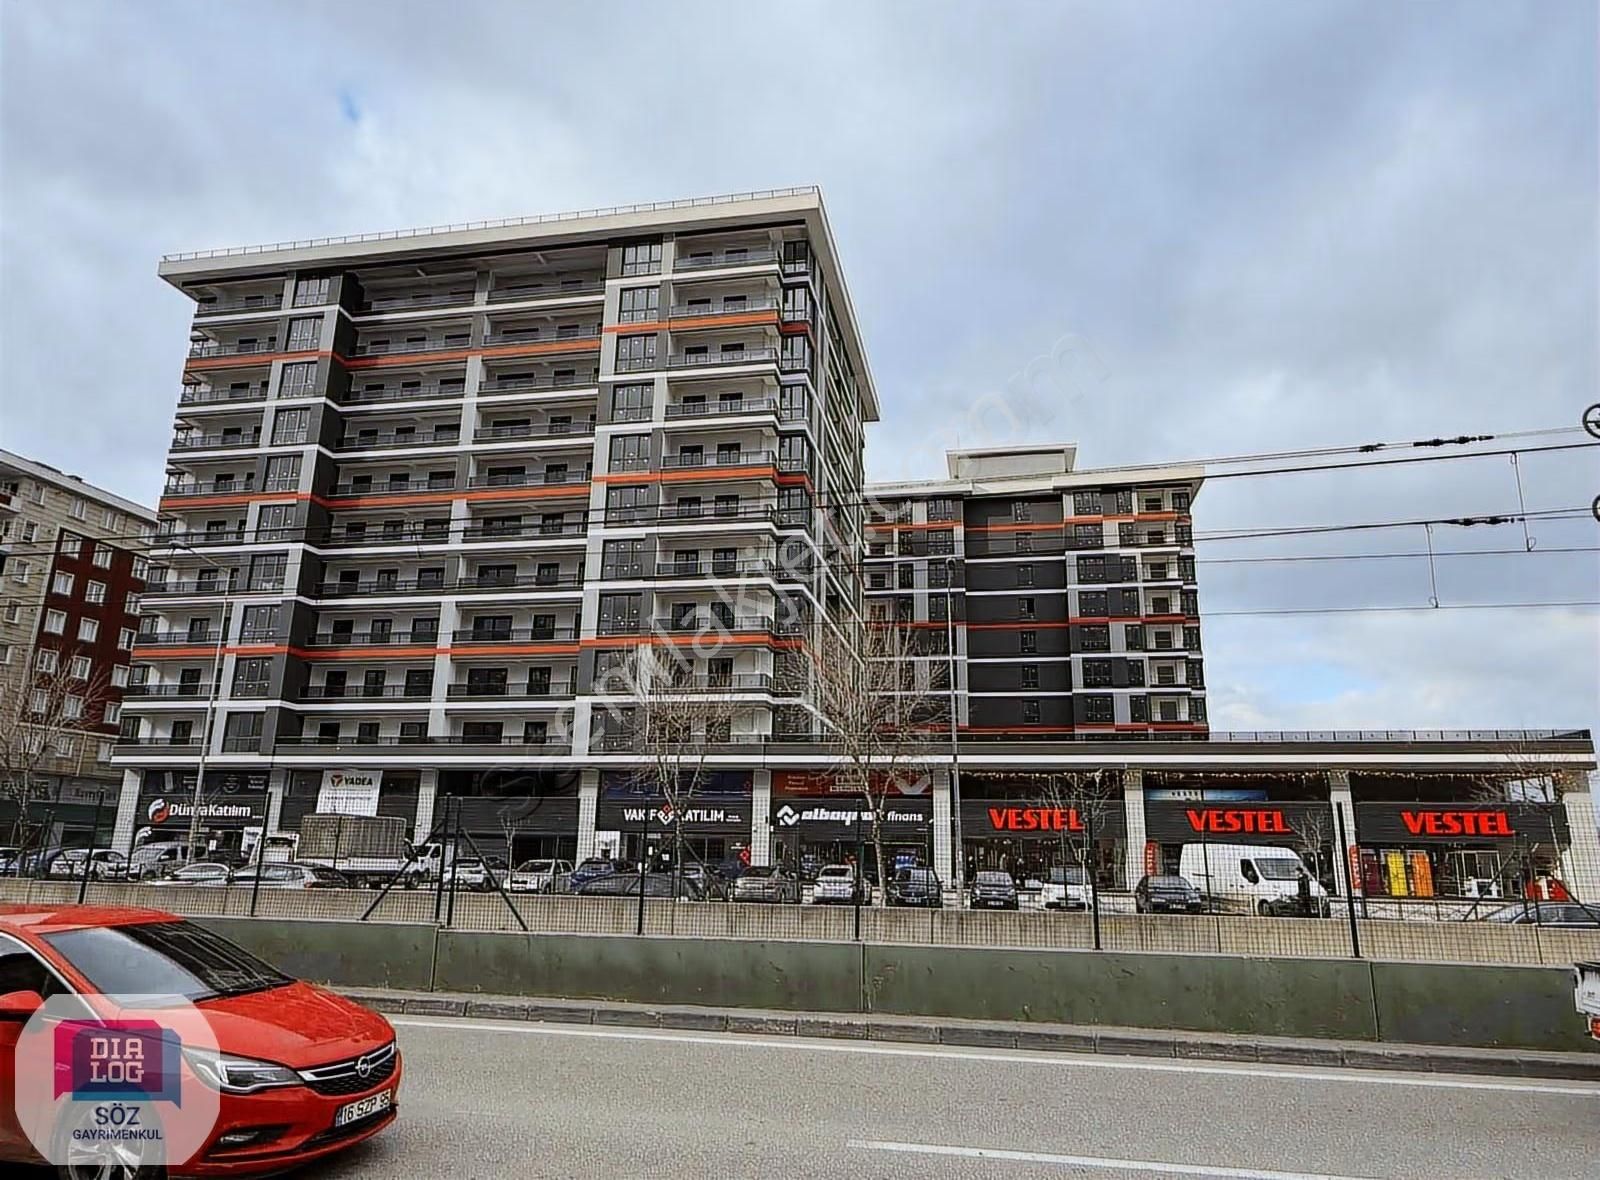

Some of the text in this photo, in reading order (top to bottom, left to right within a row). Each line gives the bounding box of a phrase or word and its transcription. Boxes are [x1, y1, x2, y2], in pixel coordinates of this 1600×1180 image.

[168, 803, 251, 817] DünaKatılım
[624, 809, 656, 822] VAKF
[887, 811, 923, 822] finans
[988, 807, 1085, 831] VESTEL
[1186, 809, 1291, 833] VESTEL
[1401, 811, 1515, 836] VESTEL
